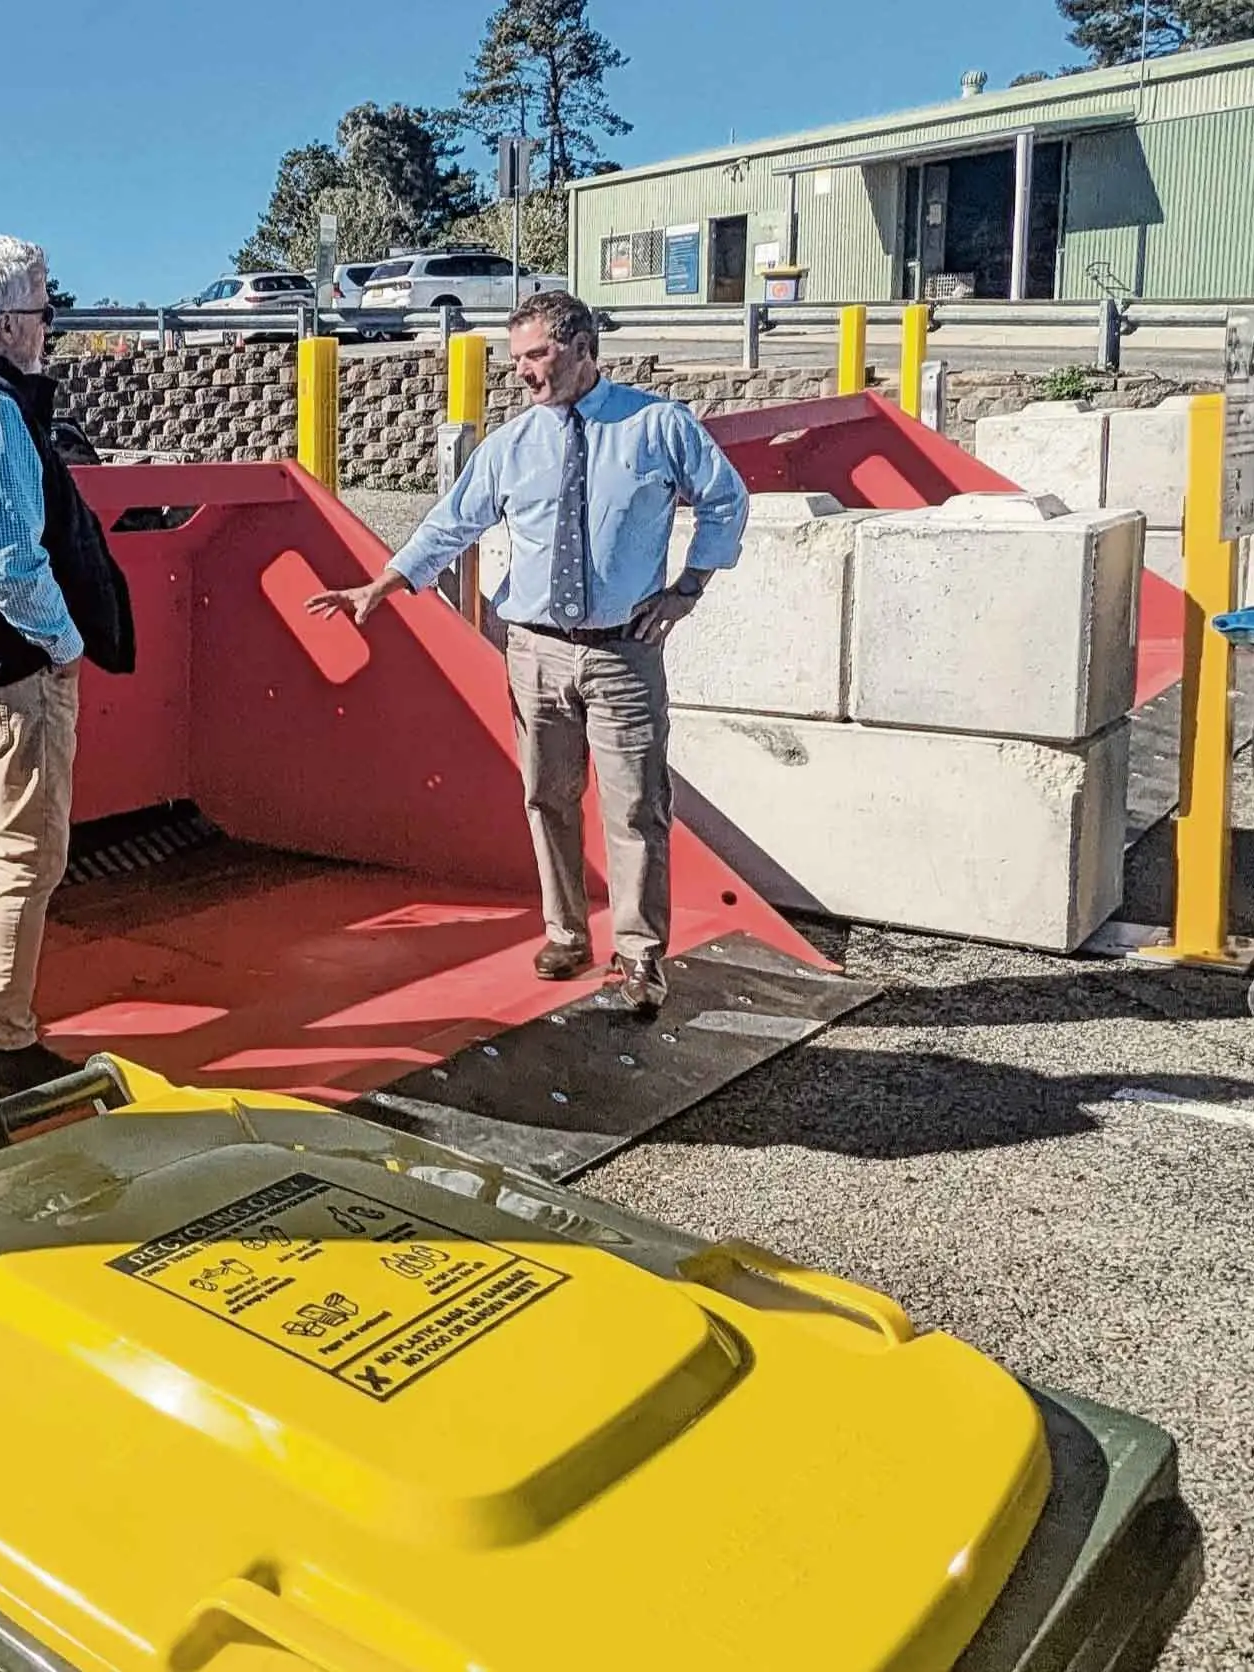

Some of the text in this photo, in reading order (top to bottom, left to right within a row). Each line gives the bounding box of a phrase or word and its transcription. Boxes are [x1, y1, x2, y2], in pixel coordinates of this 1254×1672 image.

[128, 1207, 250, 1266] RECYCLING
[374, 1350, 397, 1365] NO
[394, 1324, 440, 1355] PLASTIC
[465, 1297, 483, 1309] NO
[402, 1353, 424, 1367] NO
[418, 1335, 453, 1355] FOOD
[450, 1322, 470, 1337] OR
[464, 1299, 509, 1327] GARDEN
